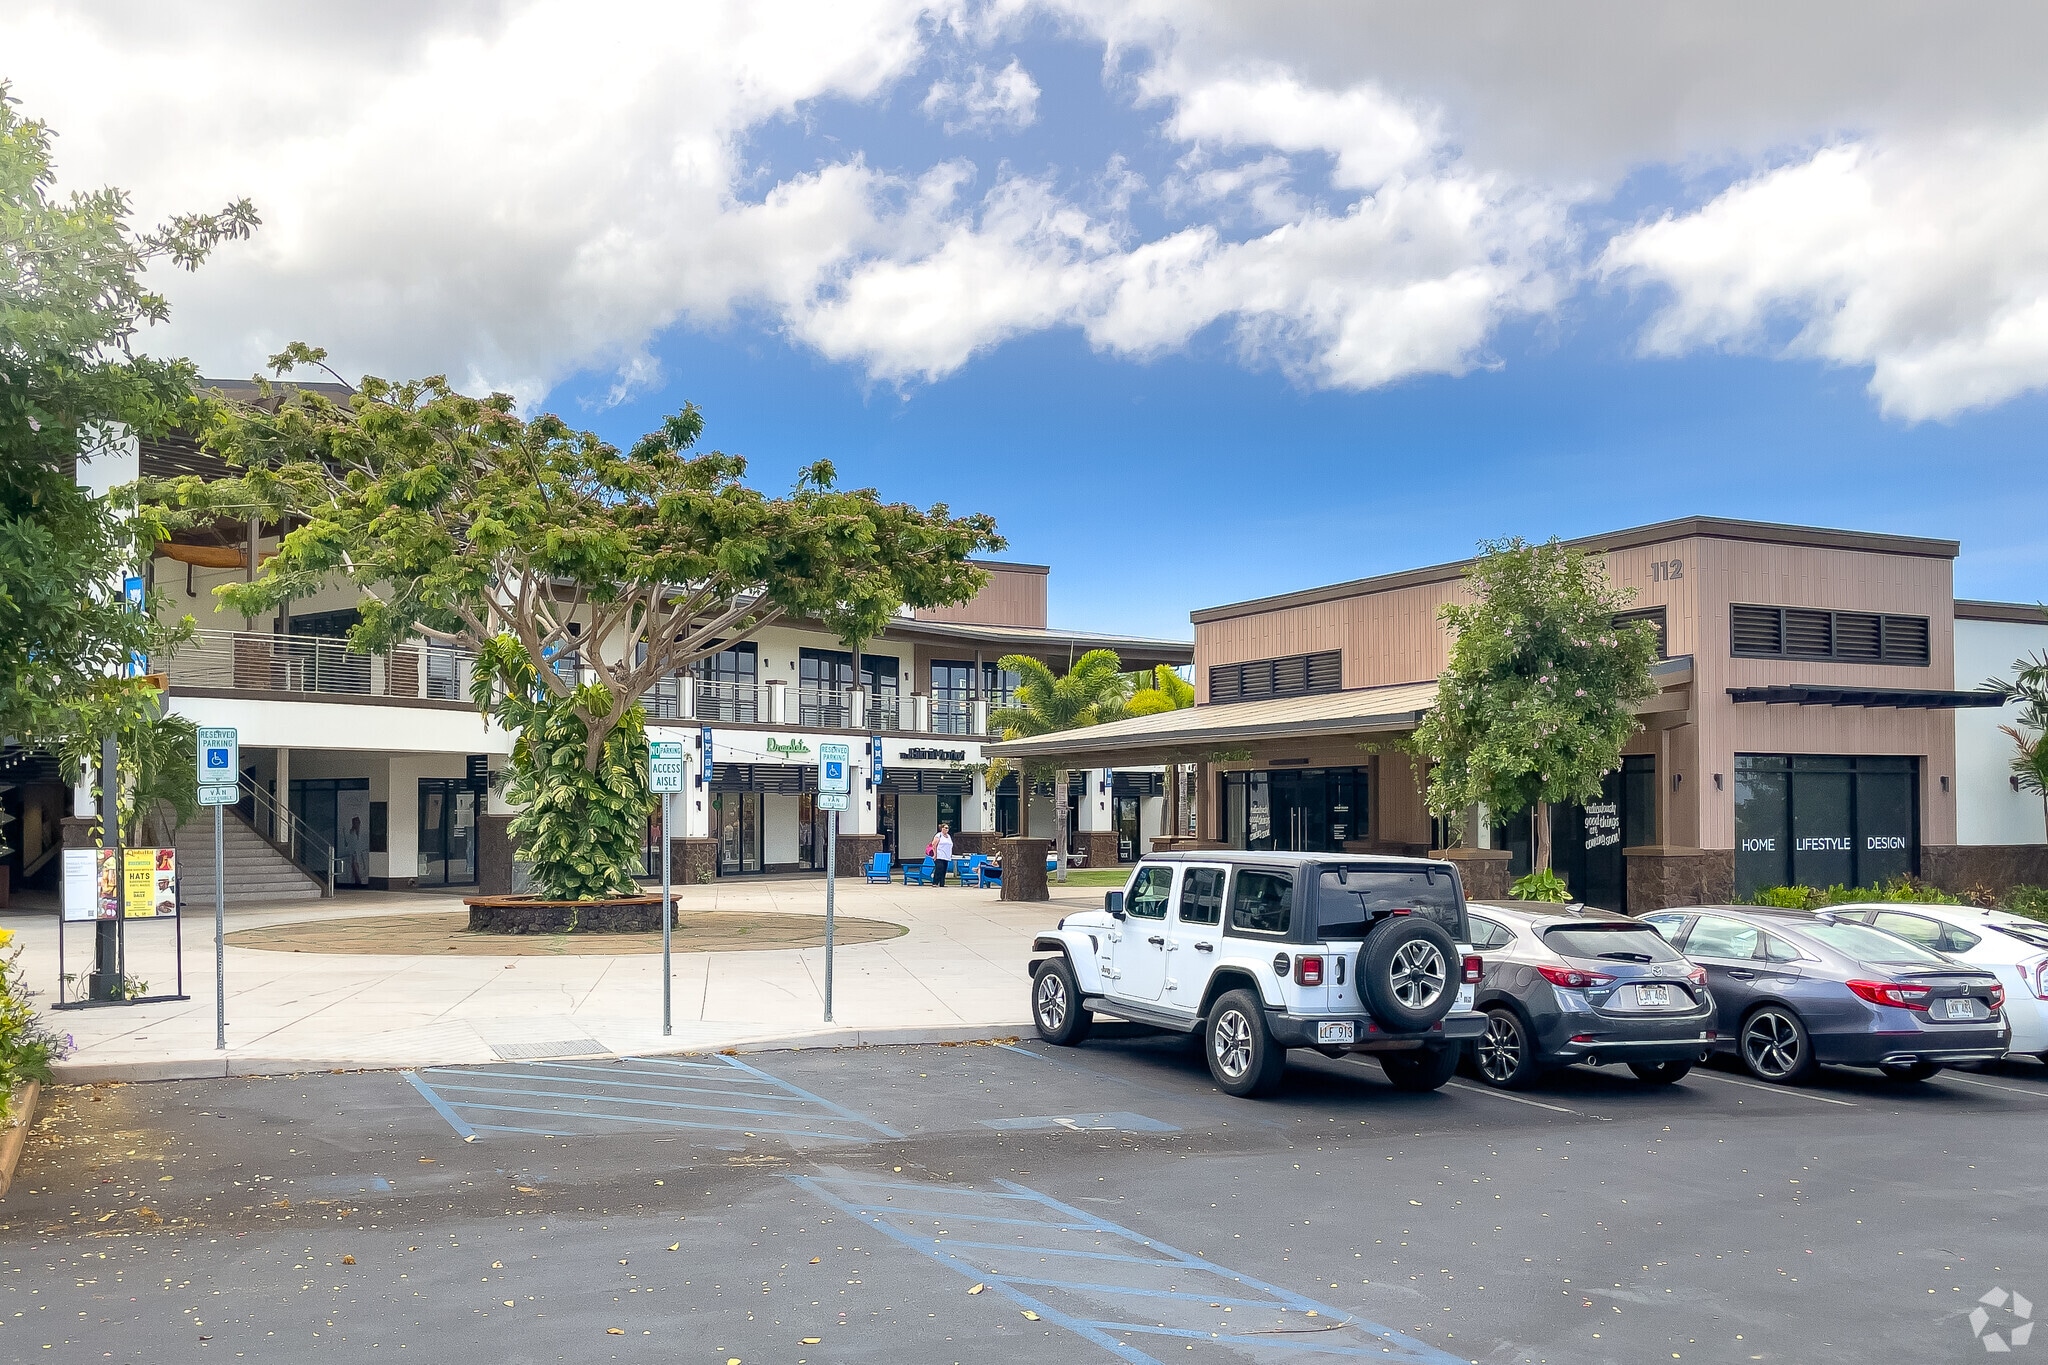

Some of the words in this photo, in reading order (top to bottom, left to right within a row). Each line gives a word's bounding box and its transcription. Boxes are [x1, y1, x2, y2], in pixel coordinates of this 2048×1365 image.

[1651, 559, 1682, 582] 112
[653, 763, 680, 773] ACCESS
[657, 776, 677, 786] AISLE
[1585, 814, 1600, 829] good
[1600, 815, 1619, 830] things
[1742, 838, 1775, 851] HOME
[1796, 837, 1851, 851] LIFESTYLE
[1867, 837, 1905, 849] DESIGN
[129, 872, 150, 880] HATS
[1320, 1026, 1333, 1038] LLF
[1339, 1026, 1353, 1038] 913
